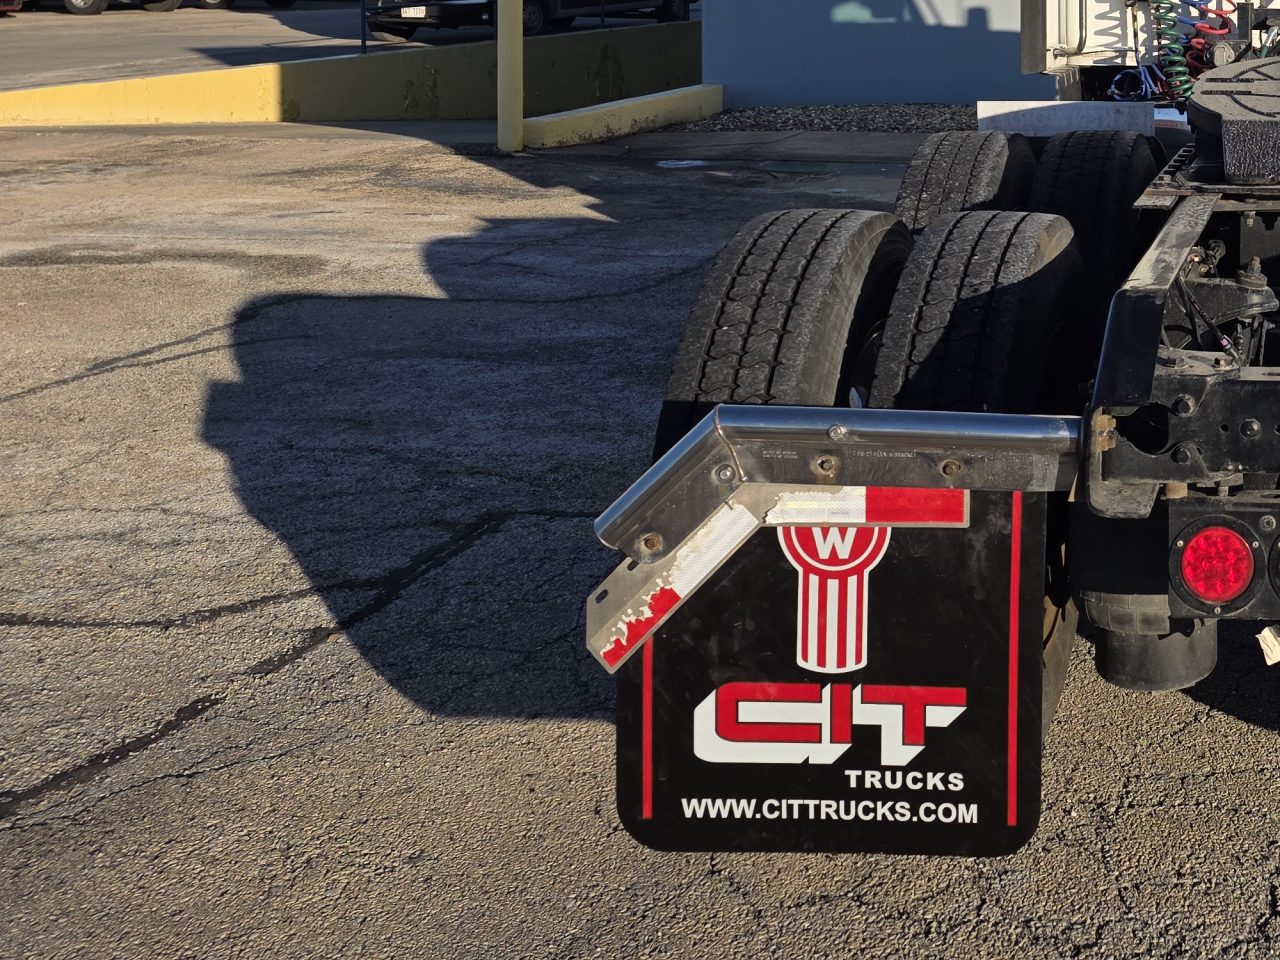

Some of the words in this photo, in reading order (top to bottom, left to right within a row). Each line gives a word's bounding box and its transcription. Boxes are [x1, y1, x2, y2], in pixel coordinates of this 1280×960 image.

[811, 526, 858, 560] W
[694, 681, 968, 766] CIT
[845, 769, 966, 792] TRUCKS
[681, 798, 979, 825] WWW.CITTRUCKS.COM
